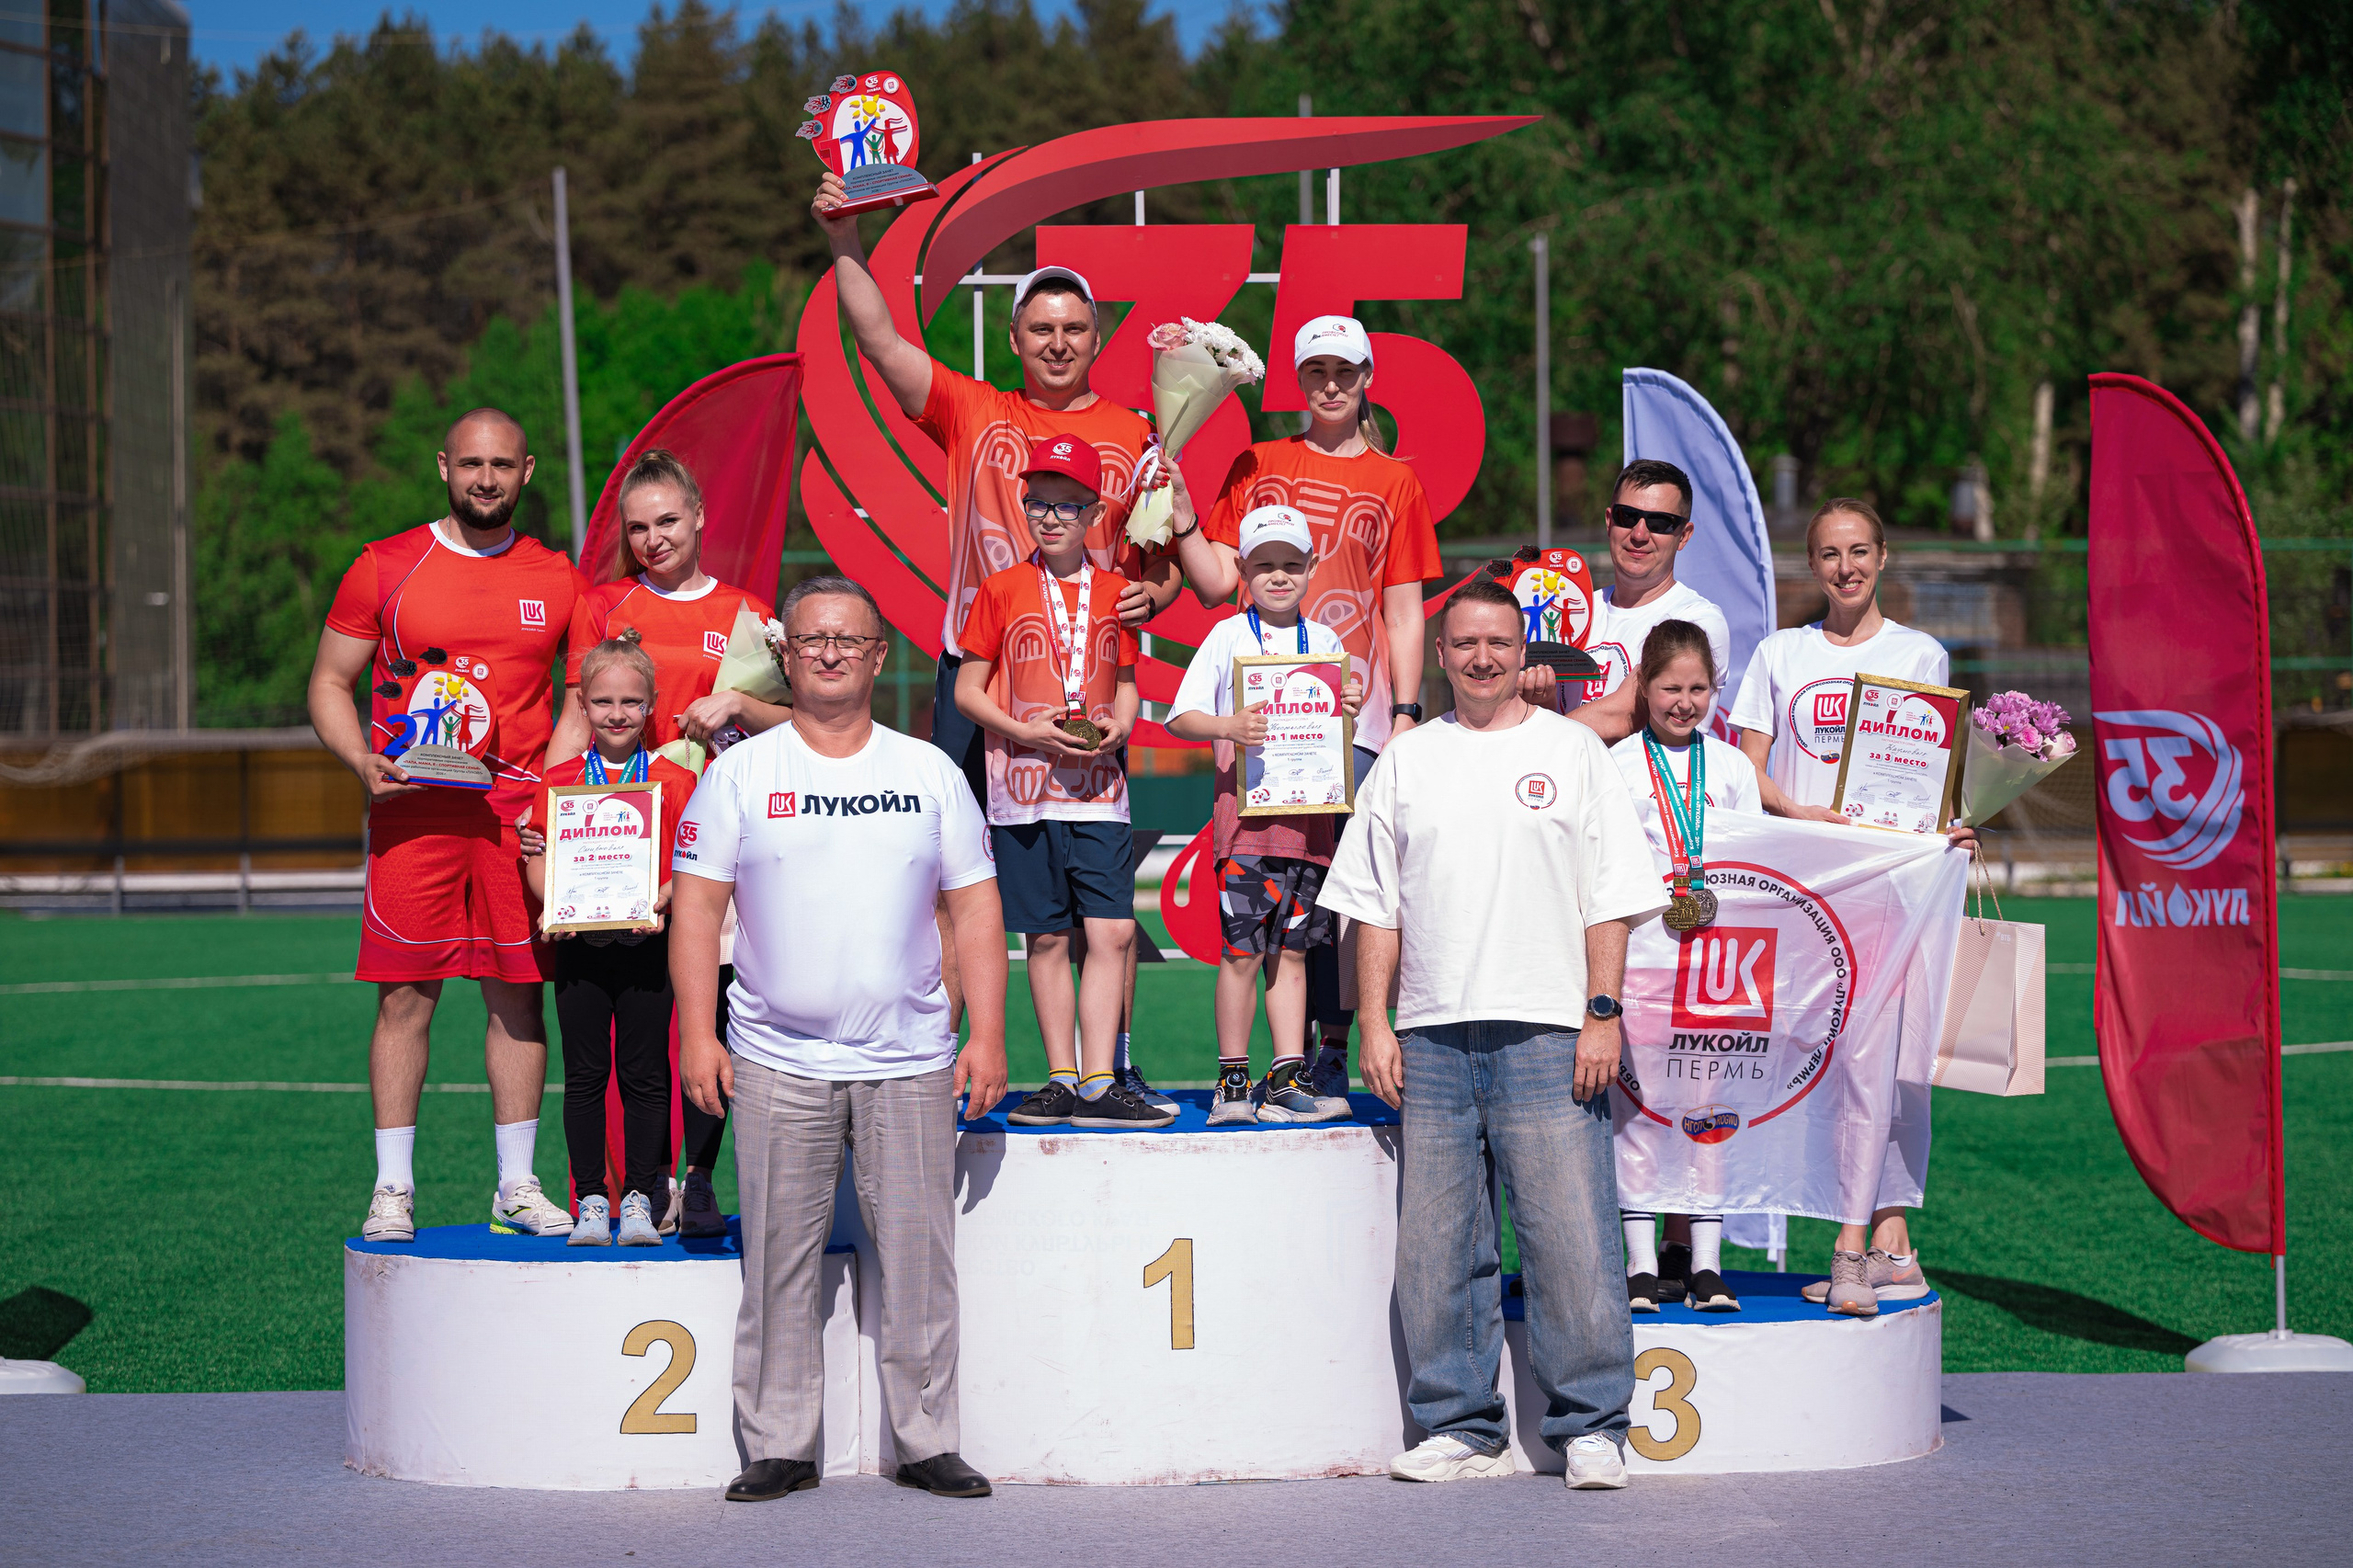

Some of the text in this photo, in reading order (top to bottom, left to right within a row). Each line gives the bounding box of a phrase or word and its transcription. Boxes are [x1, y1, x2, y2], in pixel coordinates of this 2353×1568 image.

[819, 138, 844, 179] 1
[1036, 223, 1485, 531] 35
[384, 714, 417, 756] 2
[1815, 725, 1845, 734] ЛУКОЙЛ
[1859, 719, 1938, 743] ДИПЛОМ
[1894, 757, 1927, 767] место
[802, 790, 921, 816] ЛУКОЙЛ
[560, 825, 637, 841] ДИПЛОМ
[682, 826, 697, 840] 35
[1759, 880, 1836, 945] ОРГАНИЗАЦИЯ
[1831, 947, 1846, 978] ООО
[1669, 1032, 1770, 1053] ЛУКОЙЛ
[1667, 1059, 1764, 1080] ПЕРМЬ
[1143, 1238, 1195, 1350] 1
[620, 1319, 698, 1434] 2
[1627, 1347, 1701, 1461] 3
